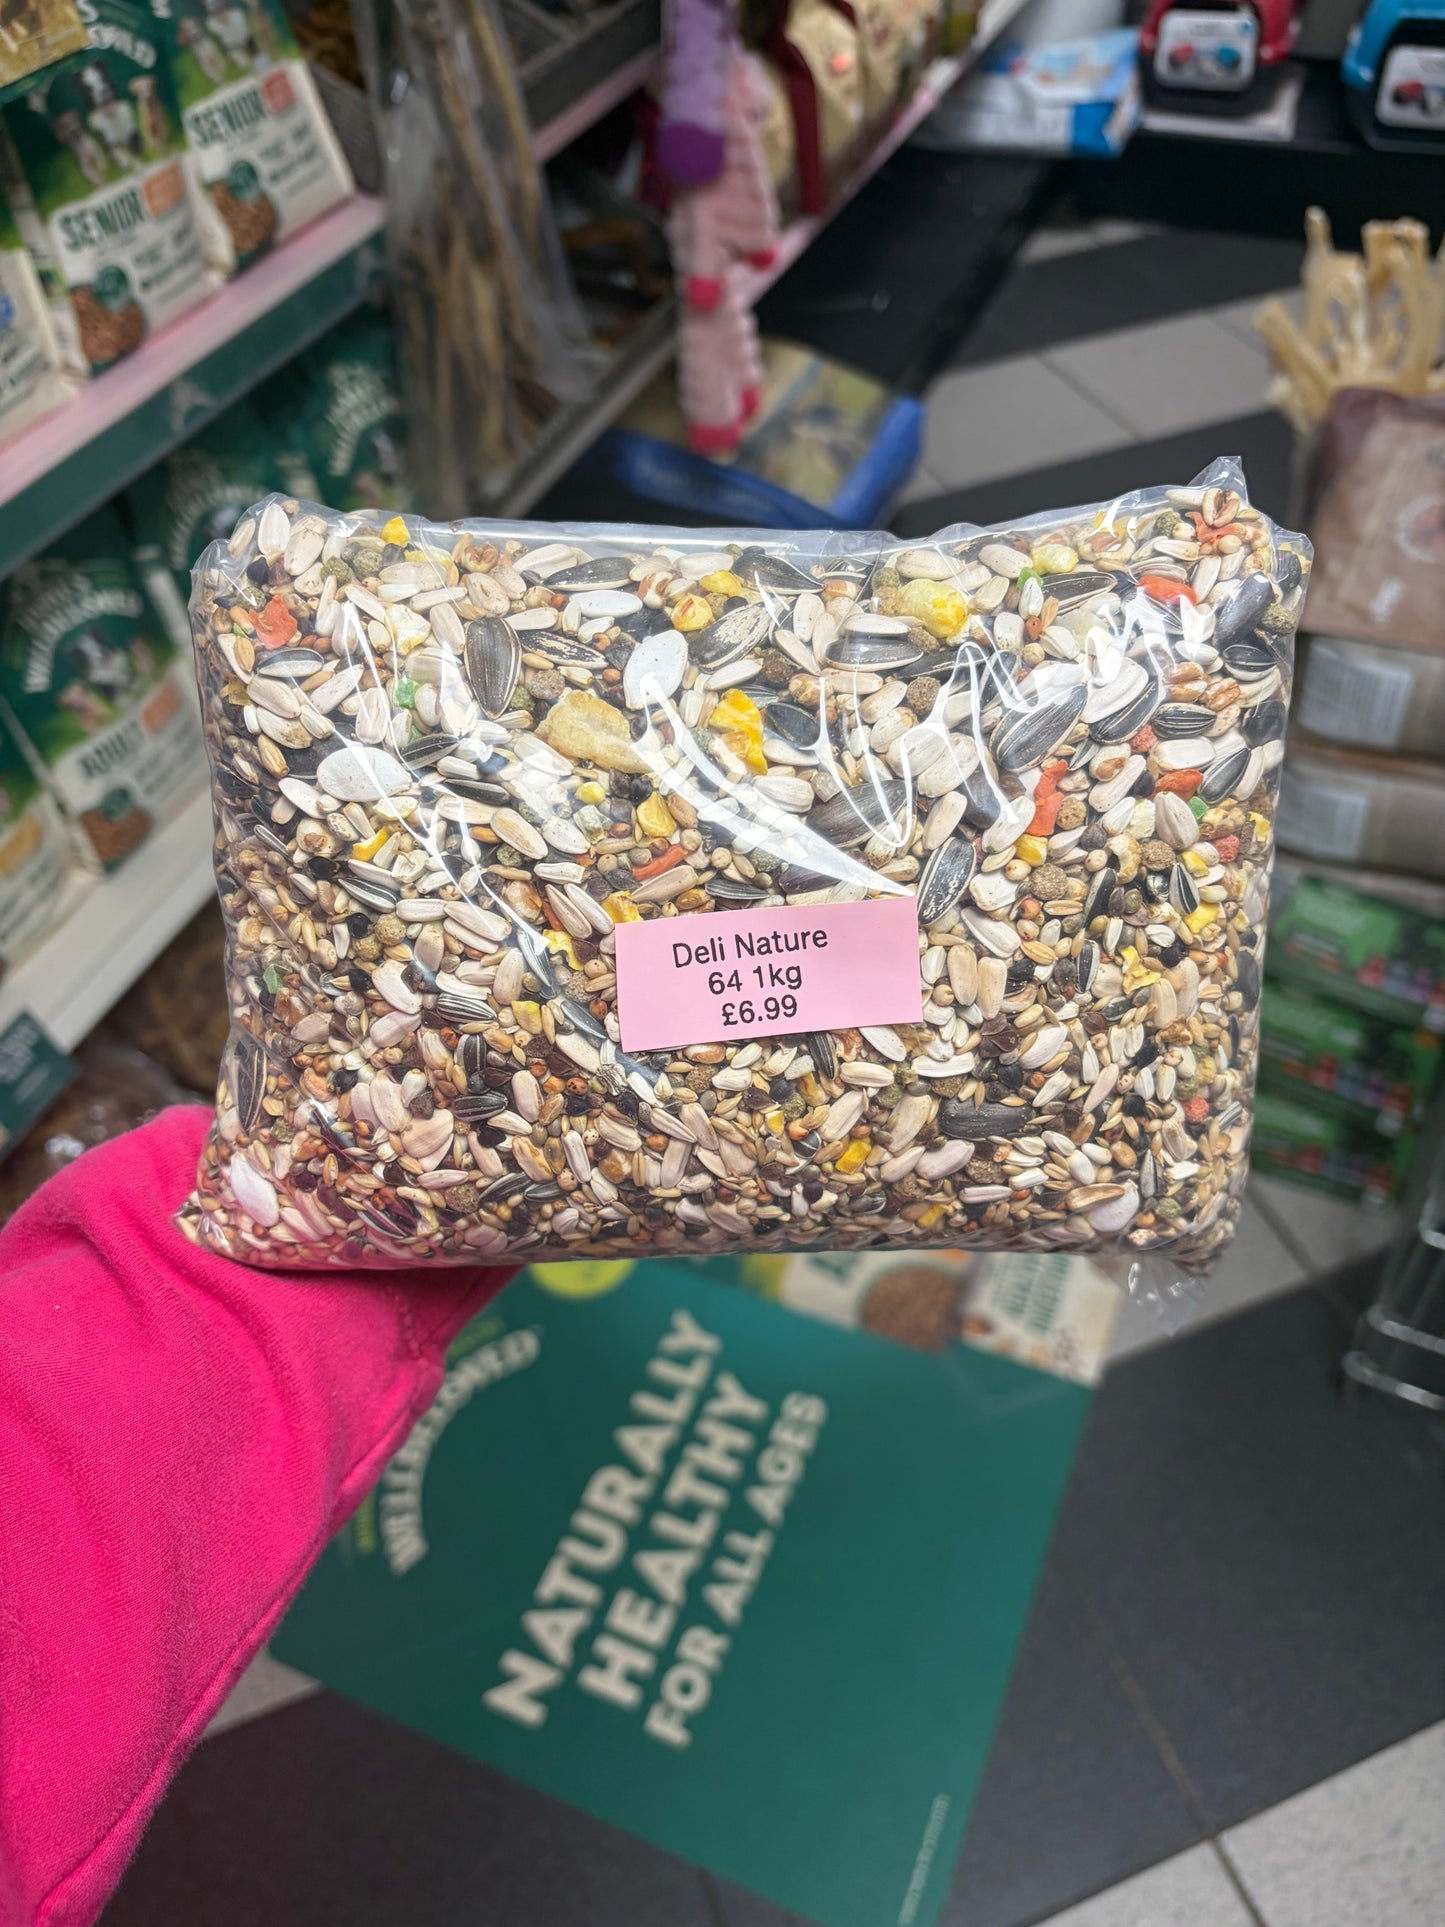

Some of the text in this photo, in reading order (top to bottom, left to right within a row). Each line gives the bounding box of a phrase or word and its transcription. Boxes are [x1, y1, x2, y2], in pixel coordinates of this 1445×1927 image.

[672, 929, 828, 968] Deli Nature
[708, 963, 802, 995] 64 1kg
[721, 994, 798, 1027] £6.99
[482, 1308, 723, 1730] NATURALLY
[577, 1371, 770, 1711] HEALTHY
[643, 1624, 731, 1751] FOR
[702, 1527, 775, 1628] ALL
[744, 1389, 829, 1529] AGES
